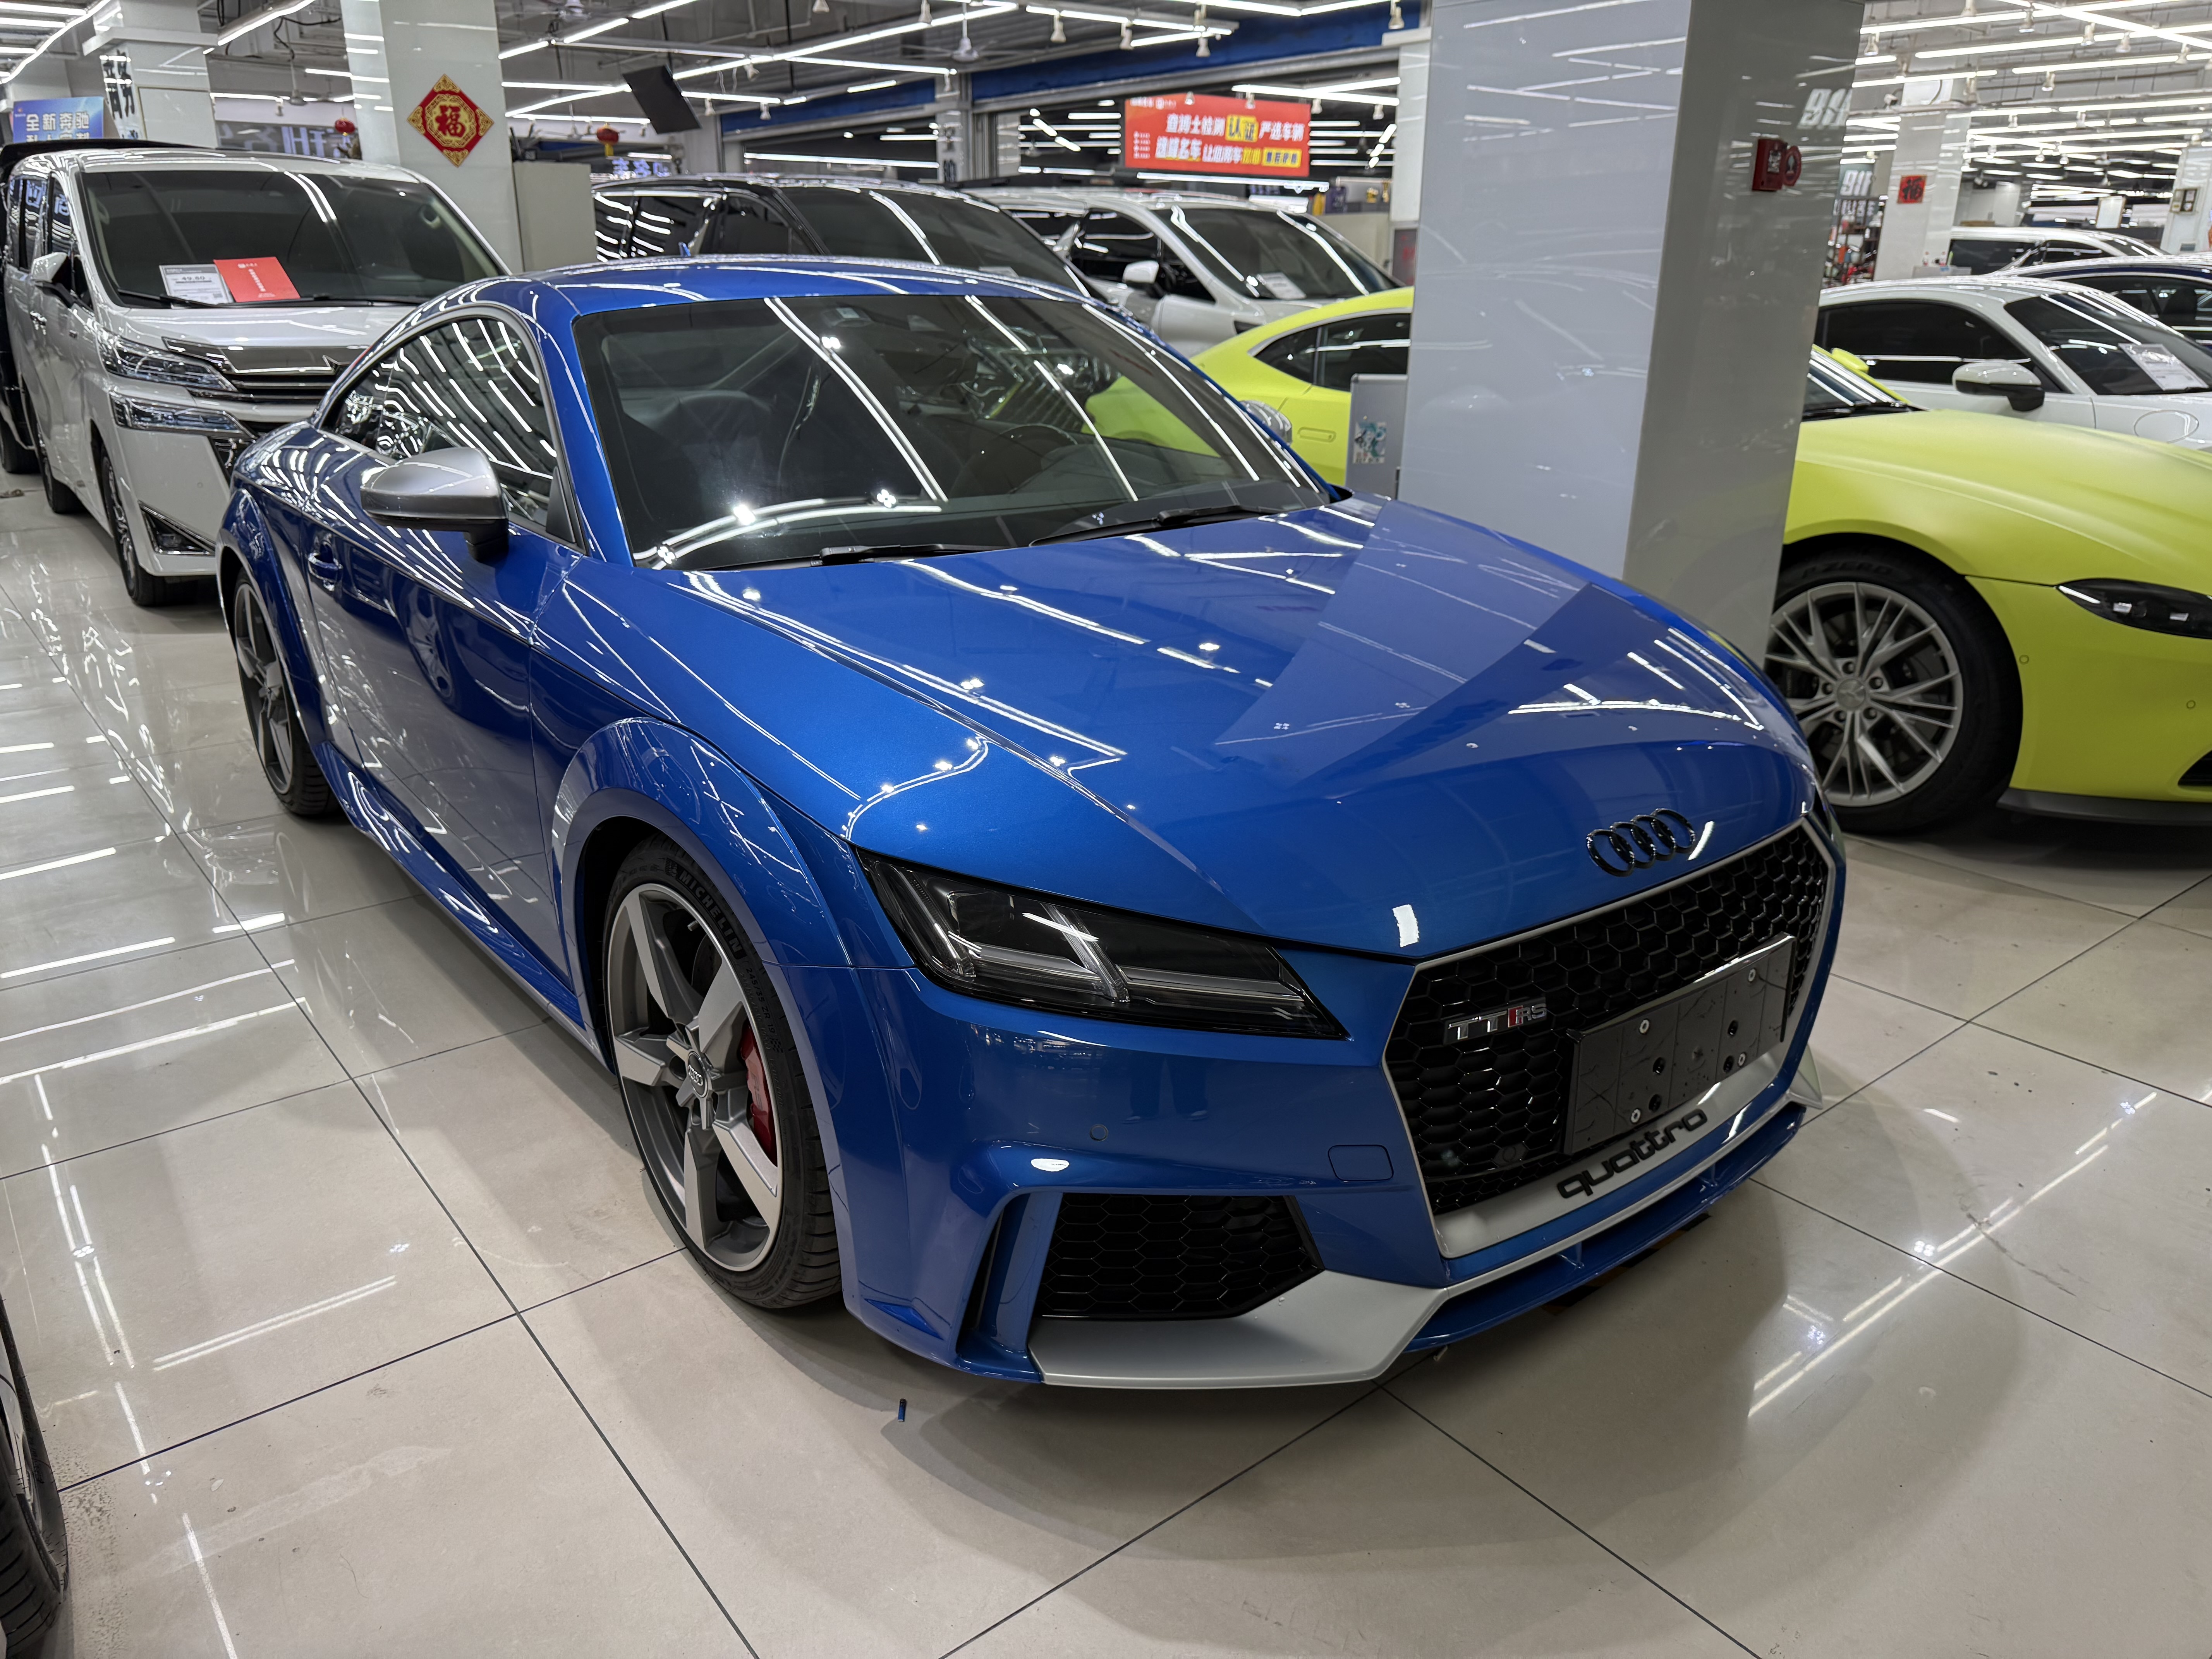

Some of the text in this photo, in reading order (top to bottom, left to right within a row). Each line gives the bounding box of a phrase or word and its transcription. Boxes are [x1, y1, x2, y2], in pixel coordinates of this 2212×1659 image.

[26, 112, 89, 132] 全新奔驰
[435, 105, 466, 137] 福
[1902, 177, 1923, 201] 福
[1821, 561, 1893, 575] ZERO
[679, 870, 743, 953] MICHELIN
[746, 967, 765, 1002] 245/35
[761, 1006, 771, 1019] ZR
[767, 1024, 776, 1034] 19
[1556, 1108, 1707, 1199] quattro
